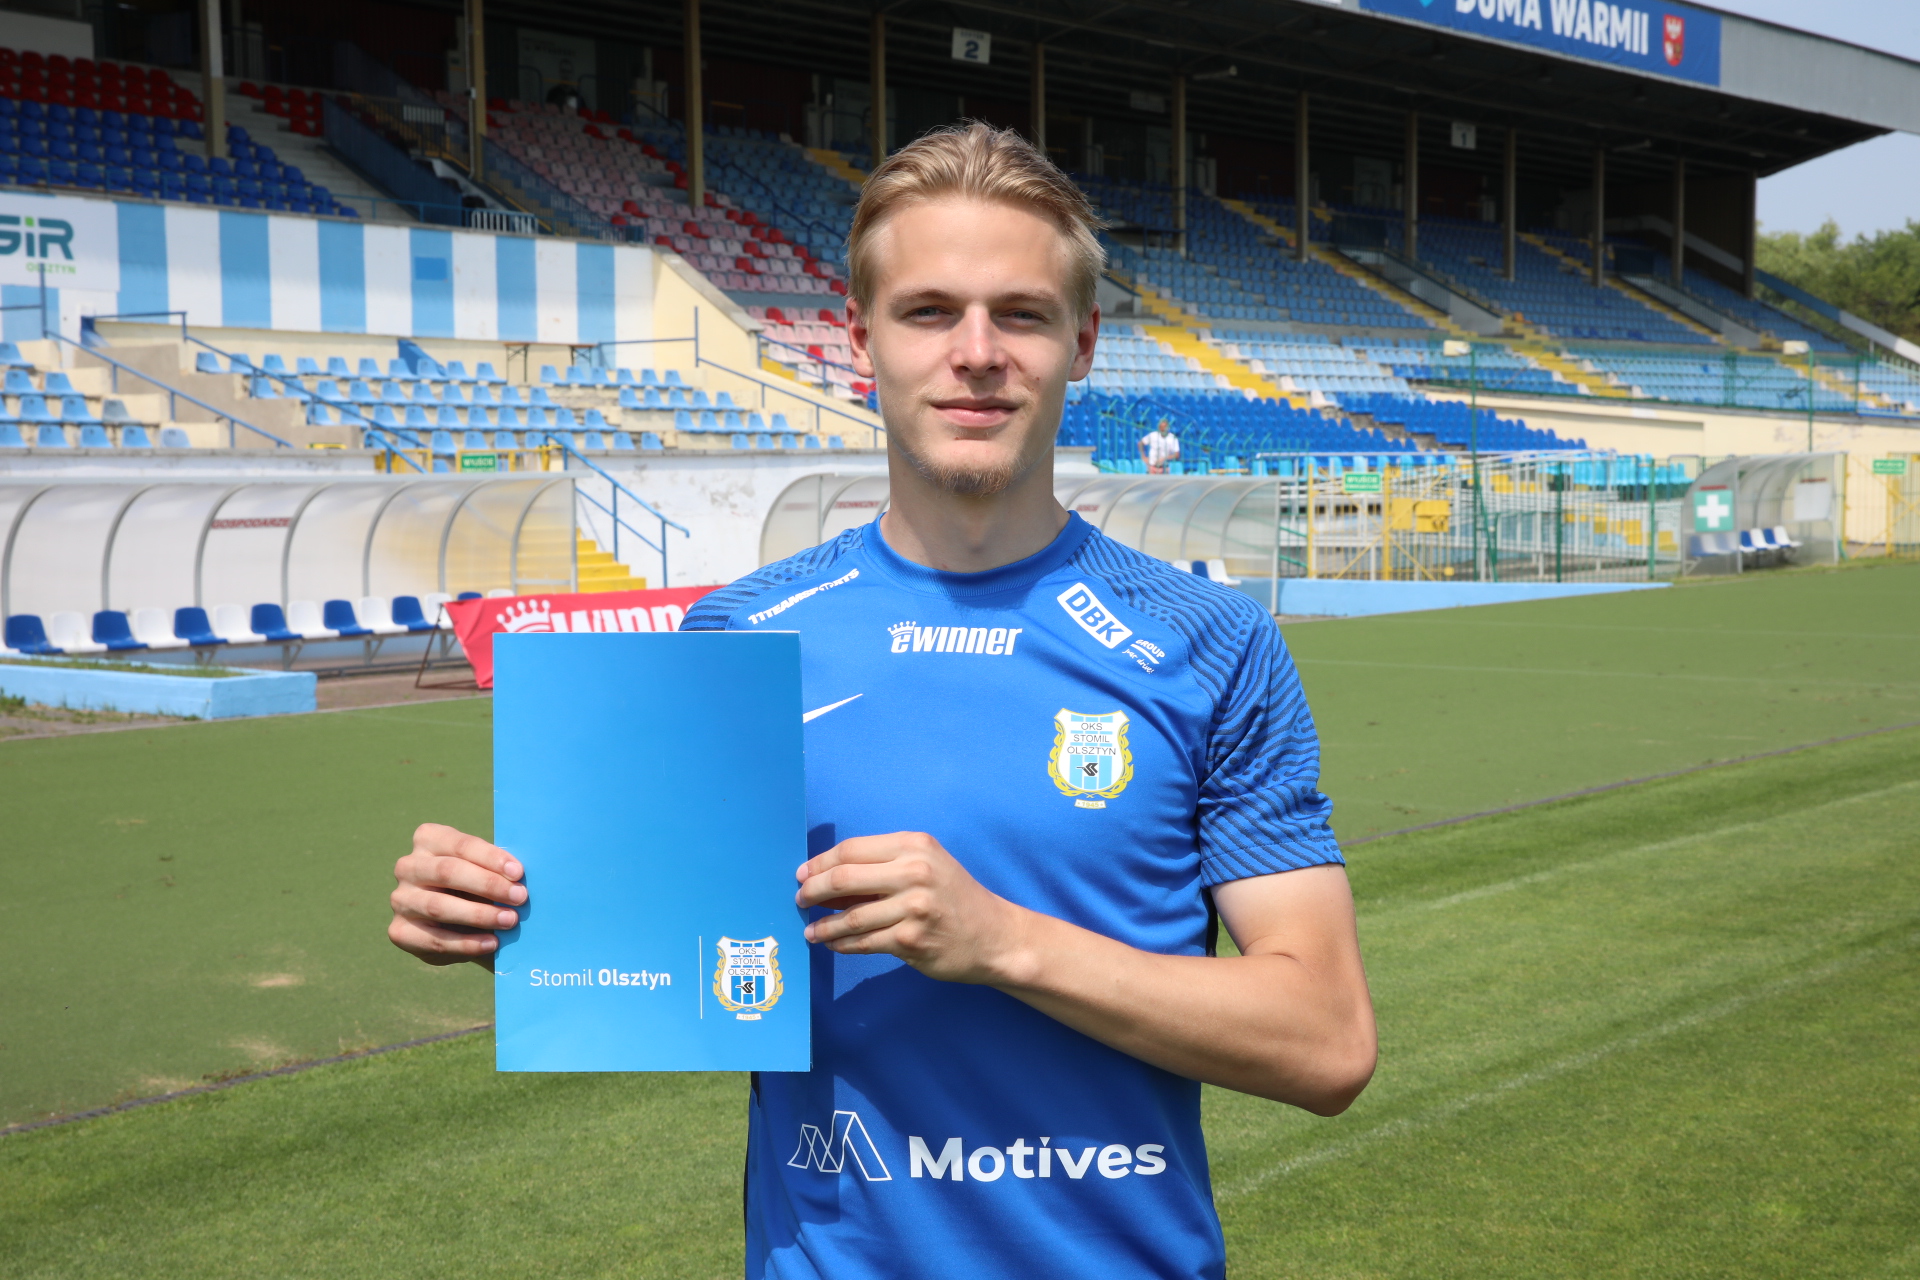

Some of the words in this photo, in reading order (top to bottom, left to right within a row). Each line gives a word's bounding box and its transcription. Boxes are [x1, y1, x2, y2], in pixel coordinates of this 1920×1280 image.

[1550, 0, 1650, 55] WARMII
[964, 40, 979, 59] 2
[1065, 589, 1125, 642] DBK
[1135, 639, 1166, 658] GROUP
[1081, 722, 1103, 731] OKS
[1073, 734, 1110, 743] STOMIL
[1067, 746, 1116, 755] OLSZTYN
[738, 947, 757, 955] OKS
[732, 957, 763, 965] STOMIL
[727, 968, 769, 976] OLSZTYN
[530, 968, 594, 987] Stomil
[598, 968, 671, 991] Olsztyn
[908, 1135, 1167, 1182] Motives
